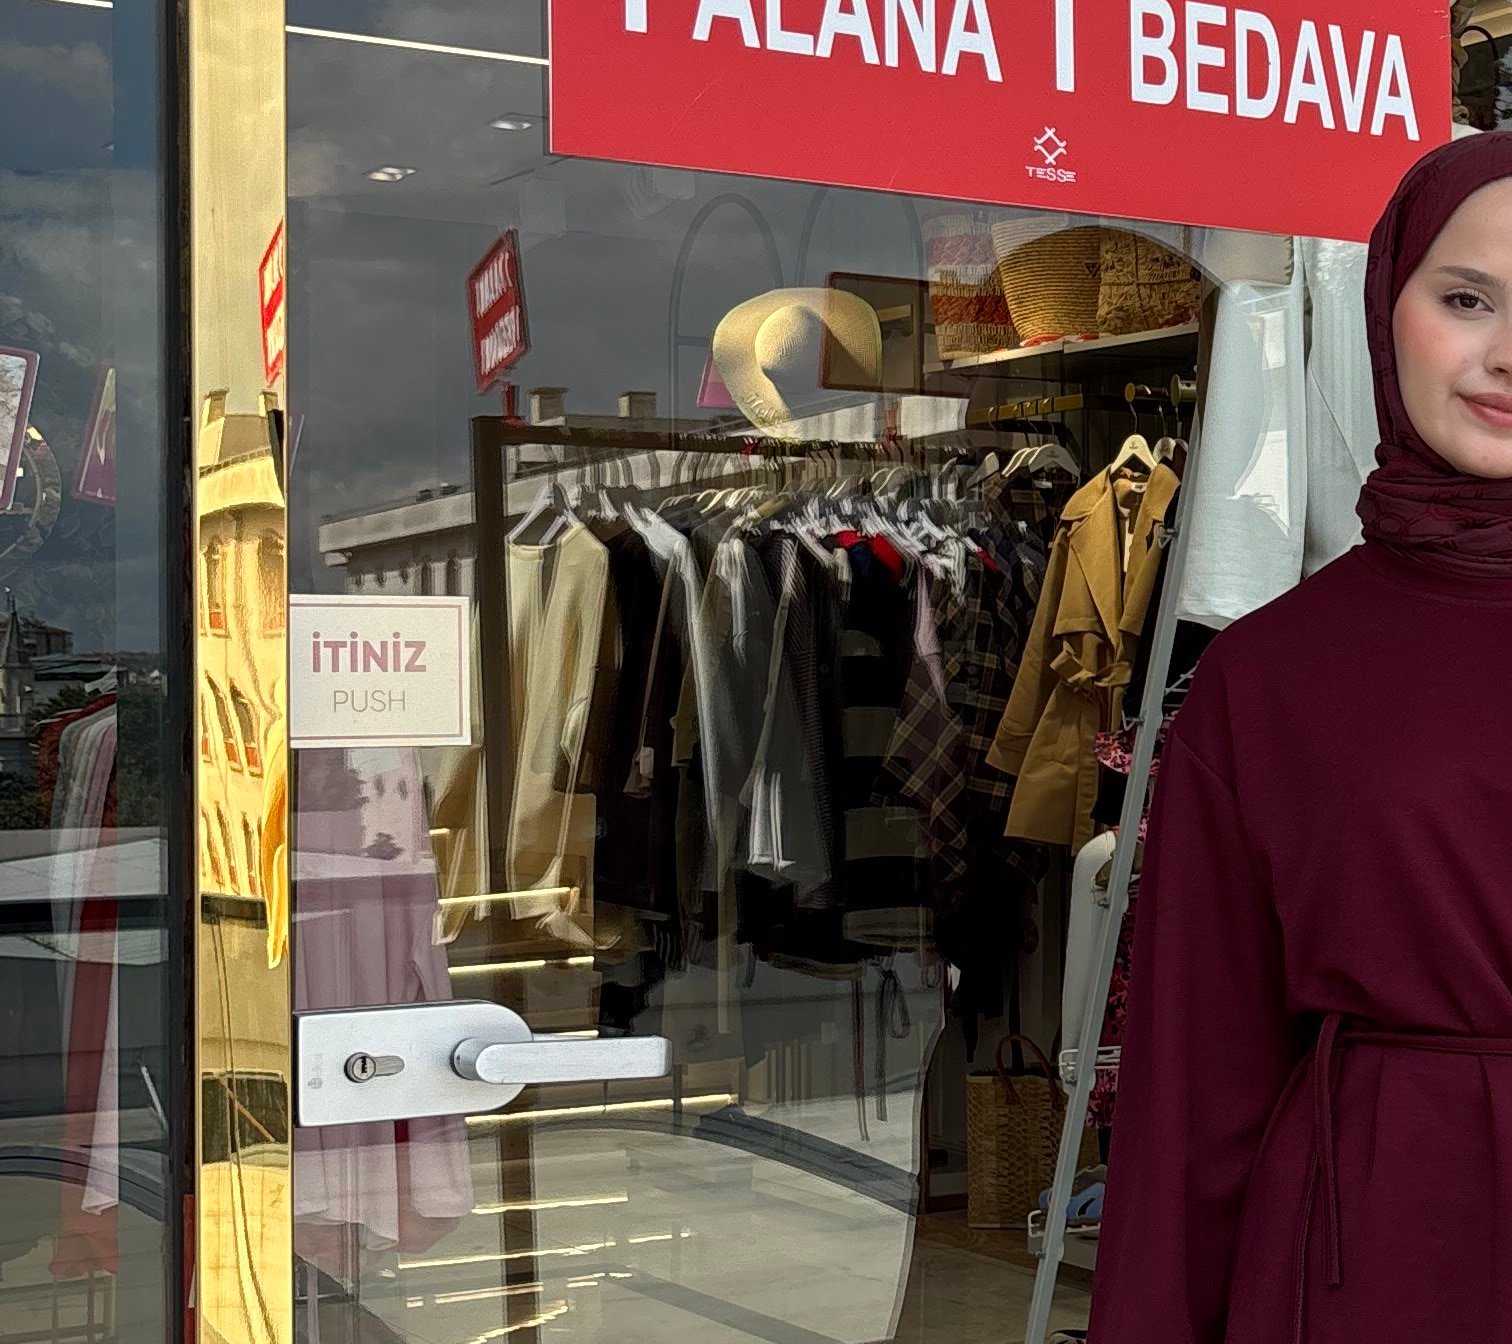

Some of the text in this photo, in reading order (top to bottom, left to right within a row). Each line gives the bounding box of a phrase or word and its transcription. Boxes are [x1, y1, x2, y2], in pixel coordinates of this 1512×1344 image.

[1024, 165, 1077, 183] TESSE
[312, 630, 427, 673] İTİNİZ
[333, 689, 406, 712] PUSH
